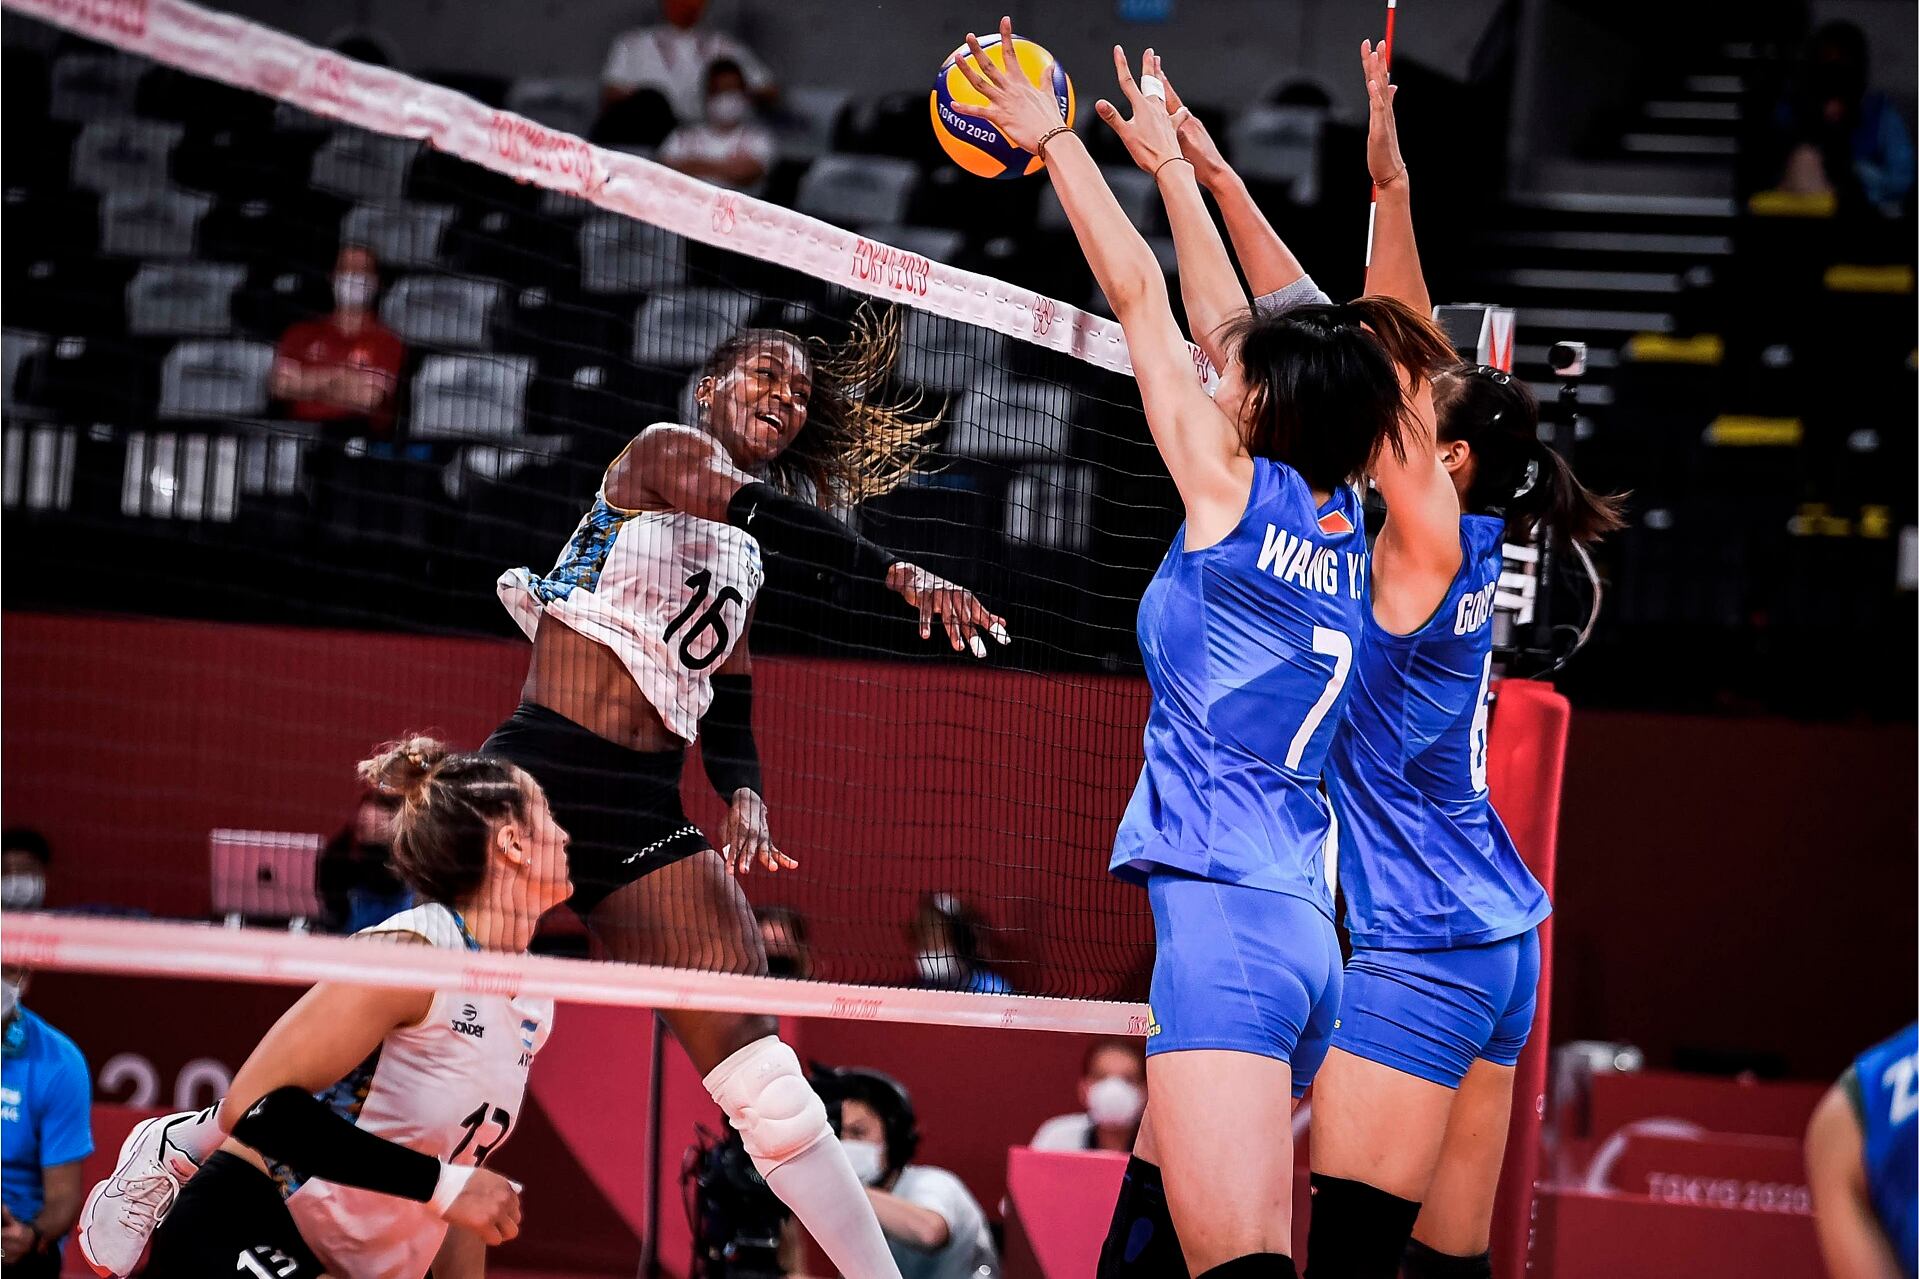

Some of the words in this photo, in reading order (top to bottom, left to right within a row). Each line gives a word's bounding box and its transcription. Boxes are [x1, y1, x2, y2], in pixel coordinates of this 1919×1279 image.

[938, 103, 967, 131] TOKYO
[966, 124, 996, 143] 2020
[1256, 523, 1338, 595] WANG
[663, 568, 743, 670] 16
[1284, 625, 1353, 771] 7
[1647, 1171, 1740, 1209] TOKYO
[236, 1245, 298, 1279] 13
